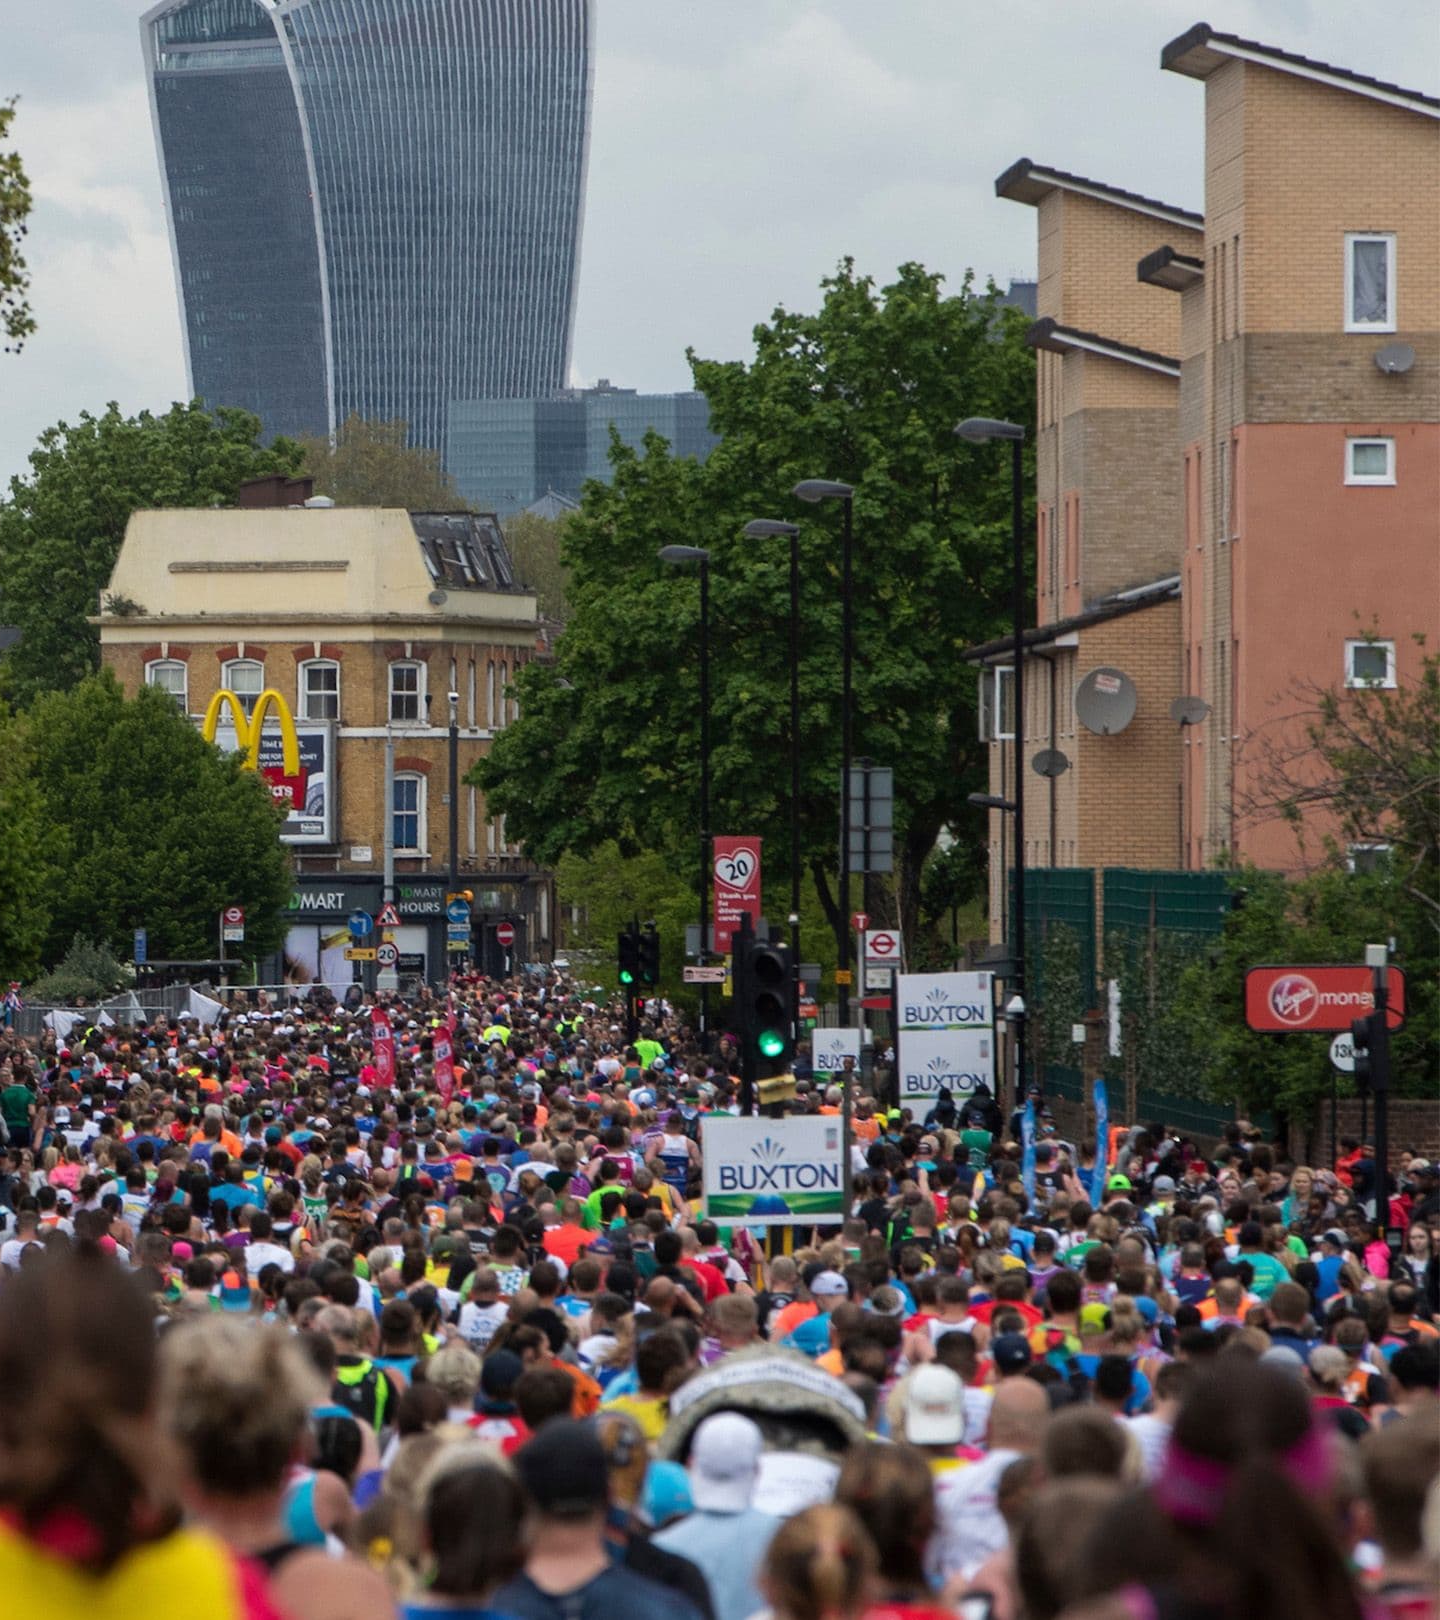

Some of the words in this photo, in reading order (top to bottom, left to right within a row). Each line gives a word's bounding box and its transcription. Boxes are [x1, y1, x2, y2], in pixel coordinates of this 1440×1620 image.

[726, 860, 748, 880] 20
[399, 902, 441, 913] HOURS
[379, 949, 395, 960] 20
[905, 1005, 985, 1023] BUXTON
[719, 1163, 839, 1191] BUXTON
